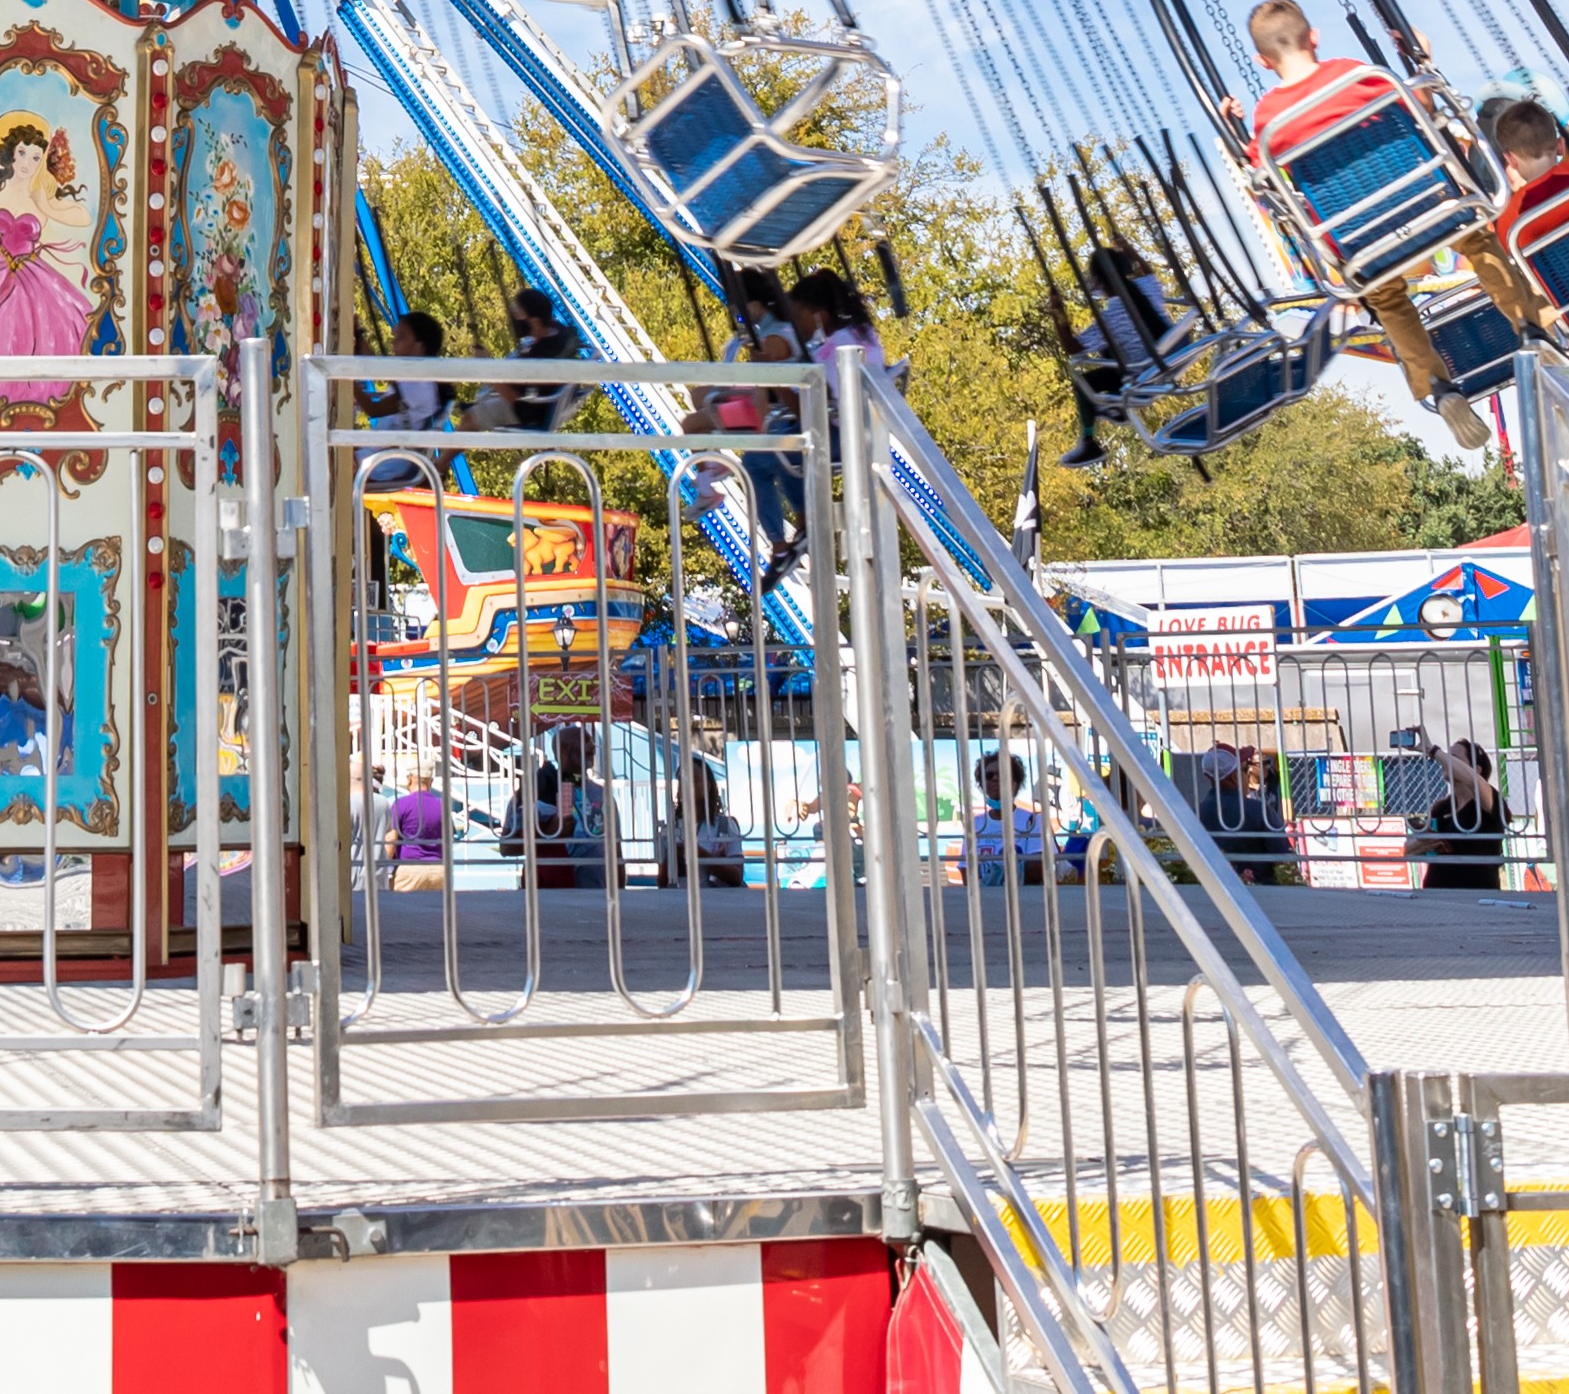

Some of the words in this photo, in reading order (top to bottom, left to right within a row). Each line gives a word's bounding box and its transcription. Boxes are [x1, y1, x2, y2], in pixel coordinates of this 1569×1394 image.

[1159, 618, 1207, 633] LOVE
[1217, 614, 1261, 632] BUG
[1155, 640, 1271, 678] ENTRANCE
